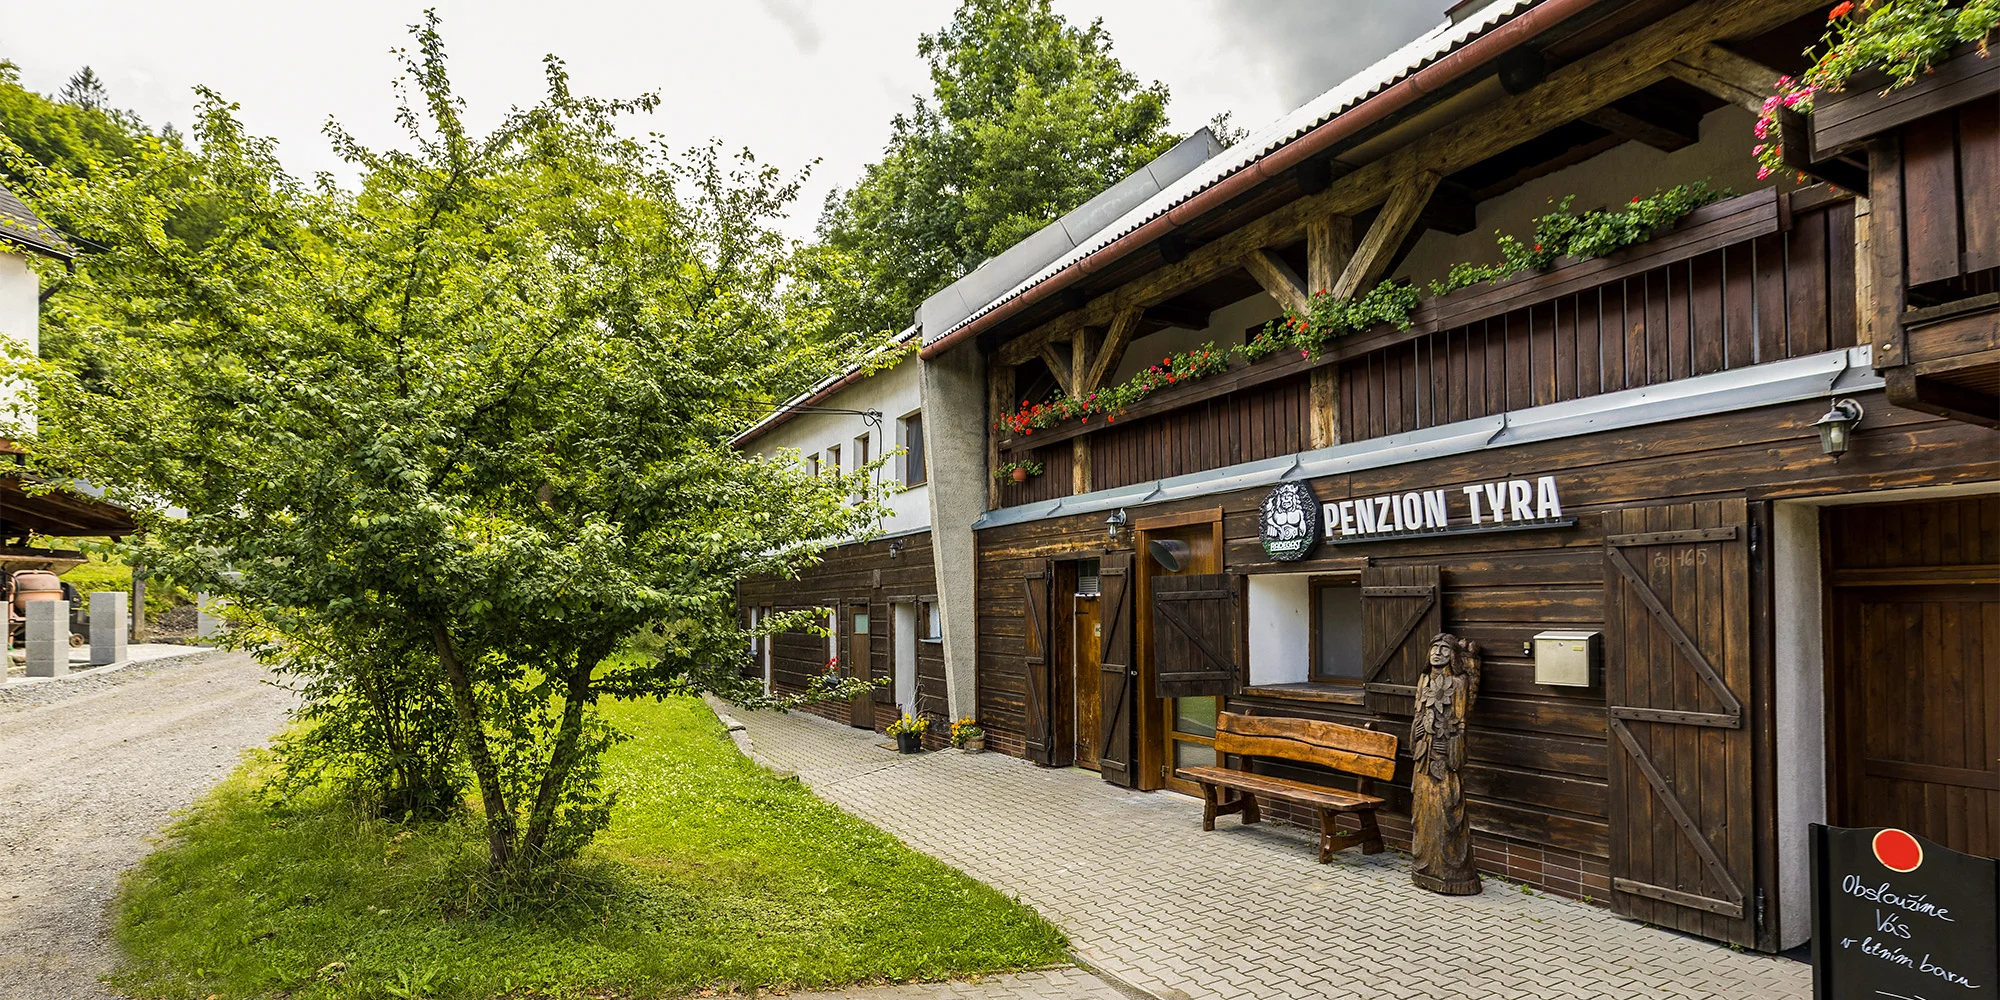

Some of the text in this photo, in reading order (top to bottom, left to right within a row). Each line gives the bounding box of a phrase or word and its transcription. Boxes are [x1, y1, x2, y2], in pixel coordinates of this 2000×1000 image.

[1322, 475, 1562, 537] PENZION TYRA
[1842, 874, 1955, 922] Obsloužíme
[1876, 908, 1911, 939] Vás
[1861, 936, 1913, 969] letním
[1919, 954, 1981, 989] baru
